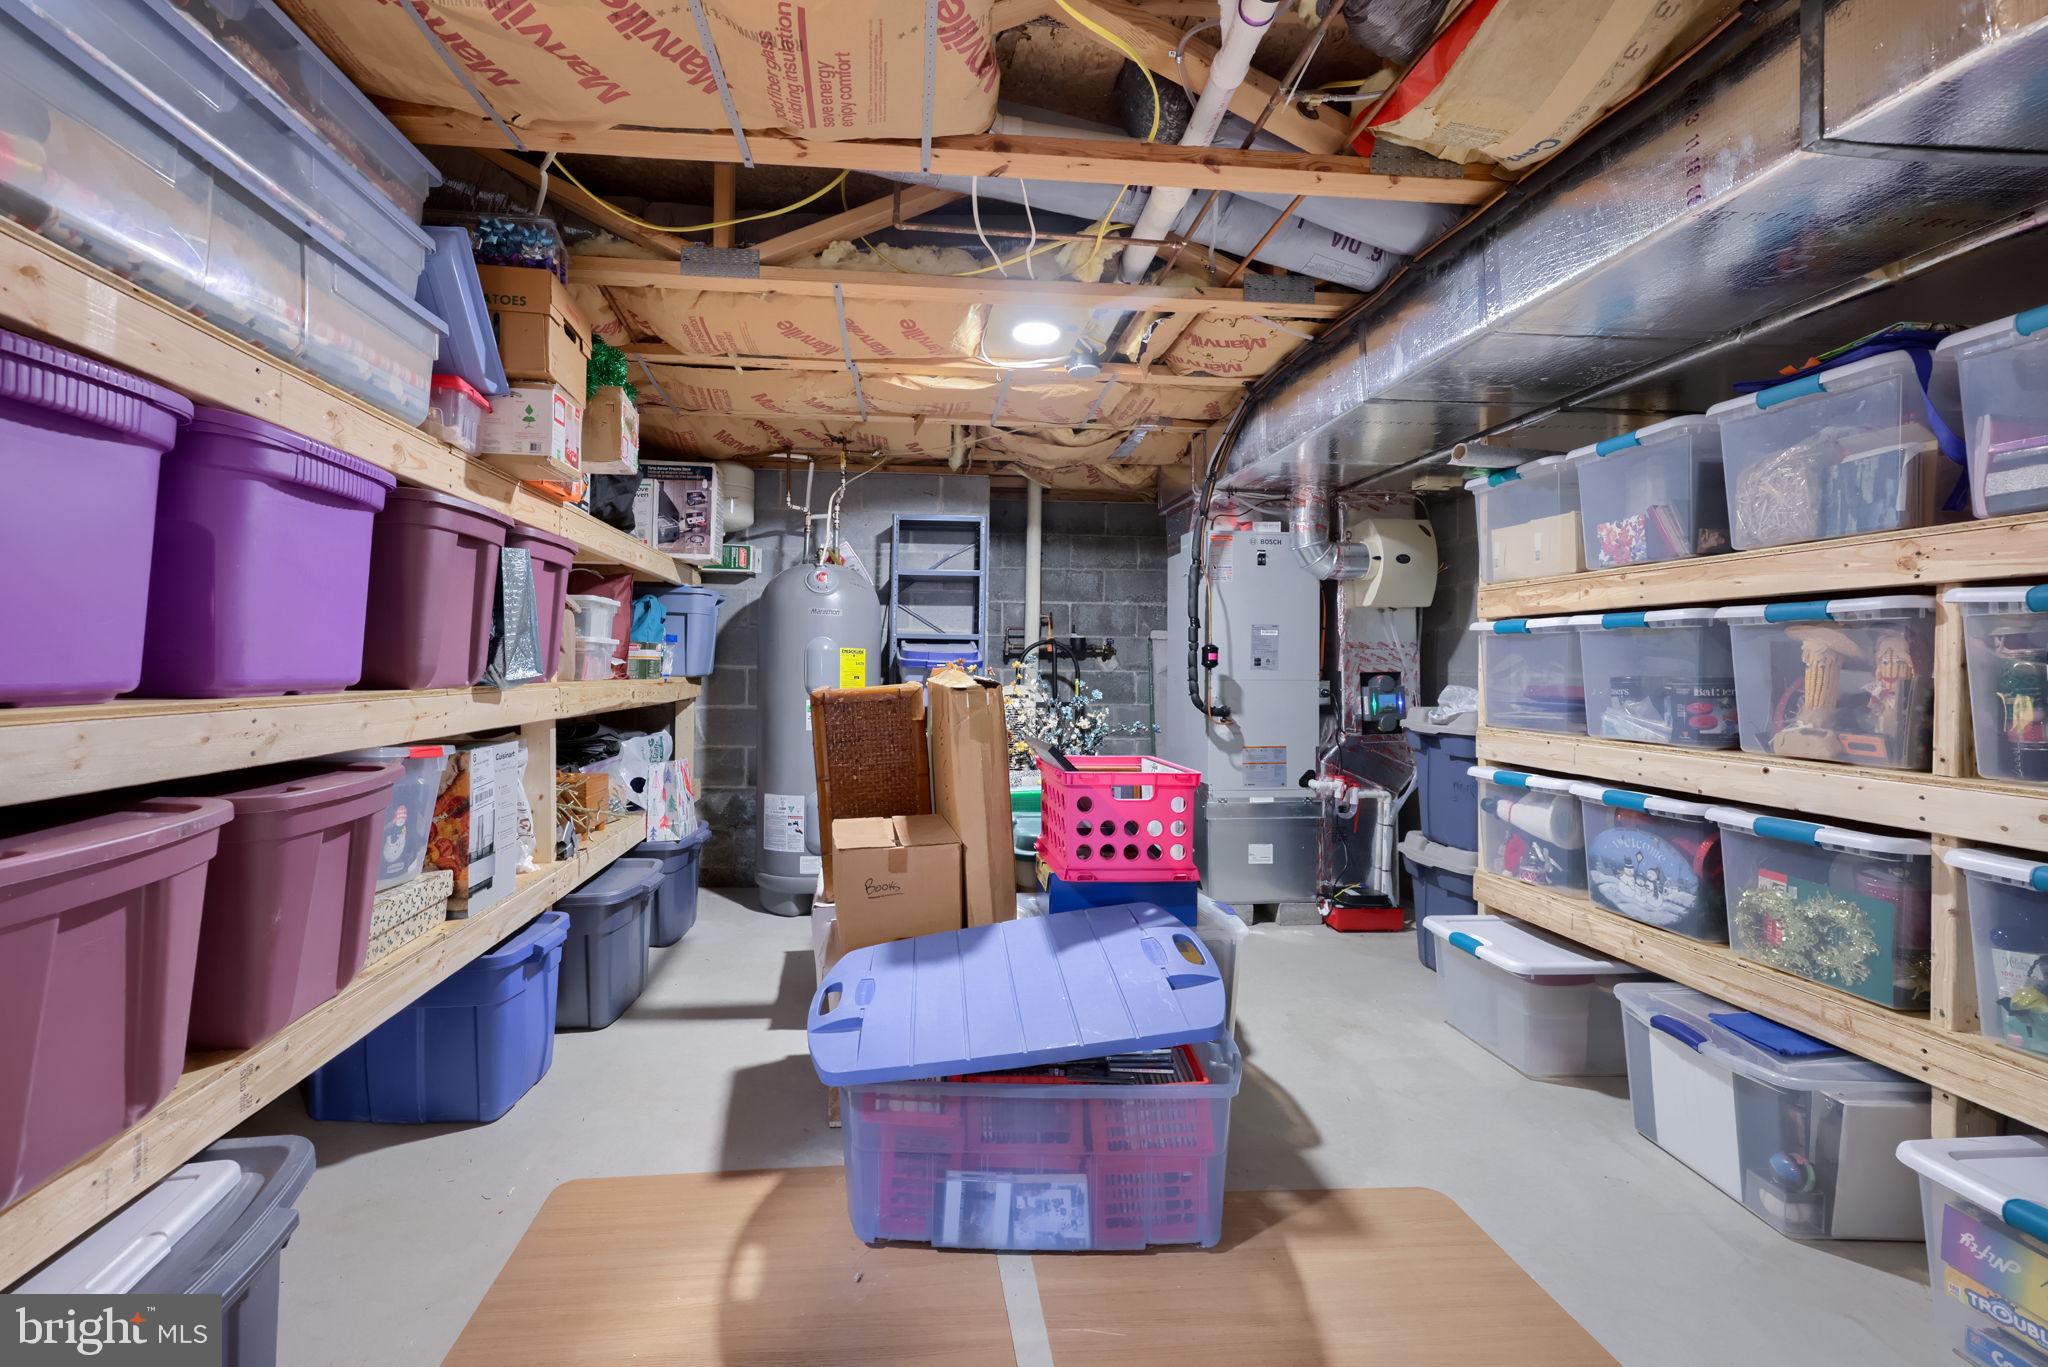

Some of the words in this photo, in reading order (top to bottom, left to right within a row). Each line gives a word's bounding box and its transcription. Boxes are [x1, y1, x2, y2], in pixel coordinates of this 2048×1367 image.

[776, 1, 799, 82] insulation
[817, 60, 835, 105] energy
[835, 51, 852, 101] comfort
[822, 106, 836, 128] save
[839, 102, 857, 128] enjoy
[1260, 538, 1282, 546] BOSCH
[495, 750, 515, 761] Cuisinart
[1967, 1291, 2048, 1346] TROUBL
